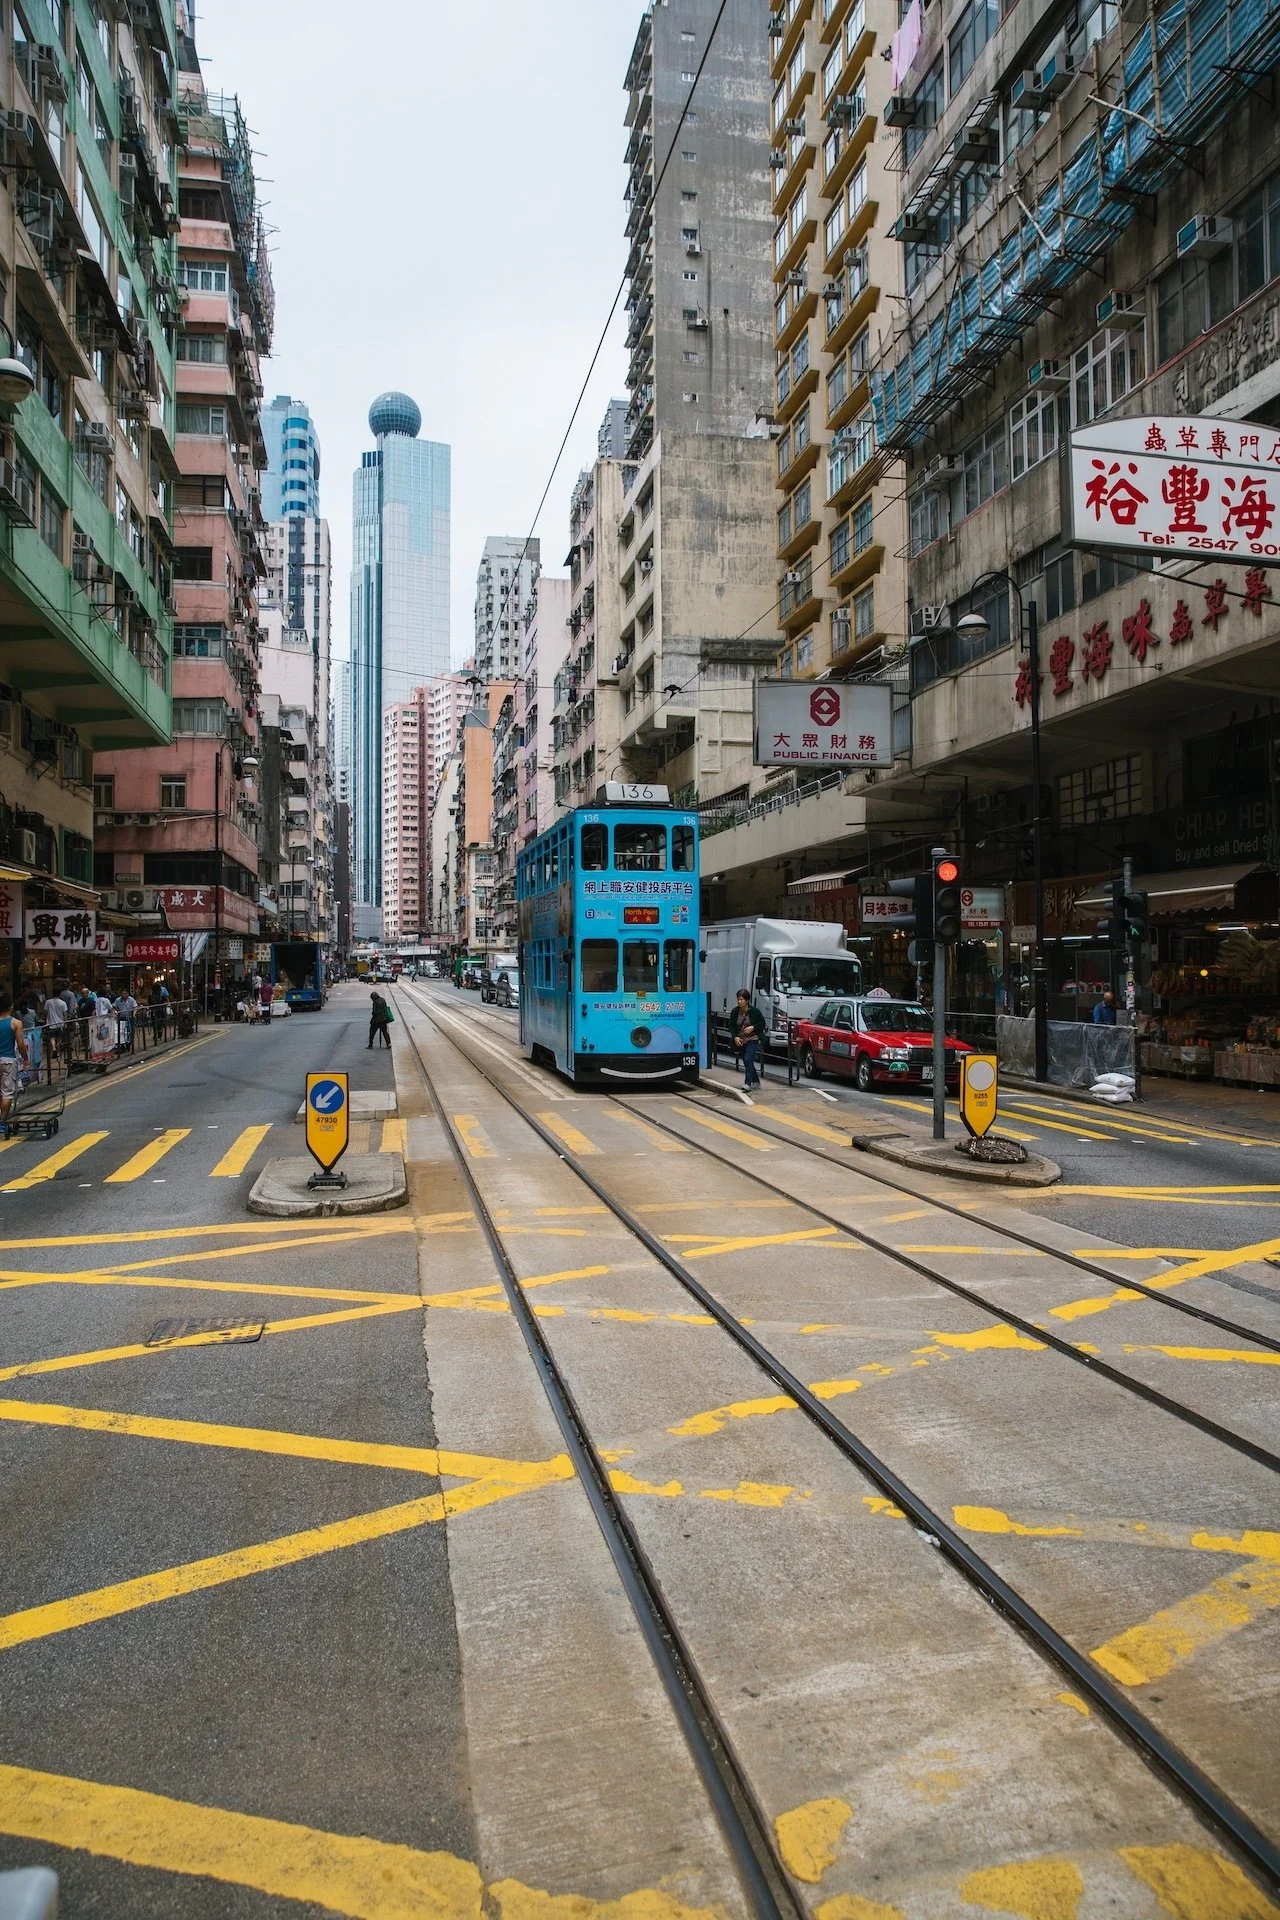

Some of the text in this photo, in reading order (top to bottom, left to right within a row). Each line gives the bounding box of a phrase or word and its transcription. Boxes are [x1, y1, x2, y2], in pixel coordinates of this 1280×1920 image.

[1085, 459, 1276, 541] 裕豐海
[1138, 531, 1280, 556] Tel: 2547 90
[773, 750, 878, 761] PUBLIC FINANCE
[621, 785, 654, 799] 136
[583, 814, 599, 823] 136
[683, 816, 696, 825] 136
[1175, 847, 1192, 865] Buy
[1194, 842, 1211, 860] and
[1232, 835, 1259, 855] Dried
[640, 1002, 660, 1013] 2542
[683, 1056, 696, 1066] 136
[316, 1116, 338, 1124] 47930
